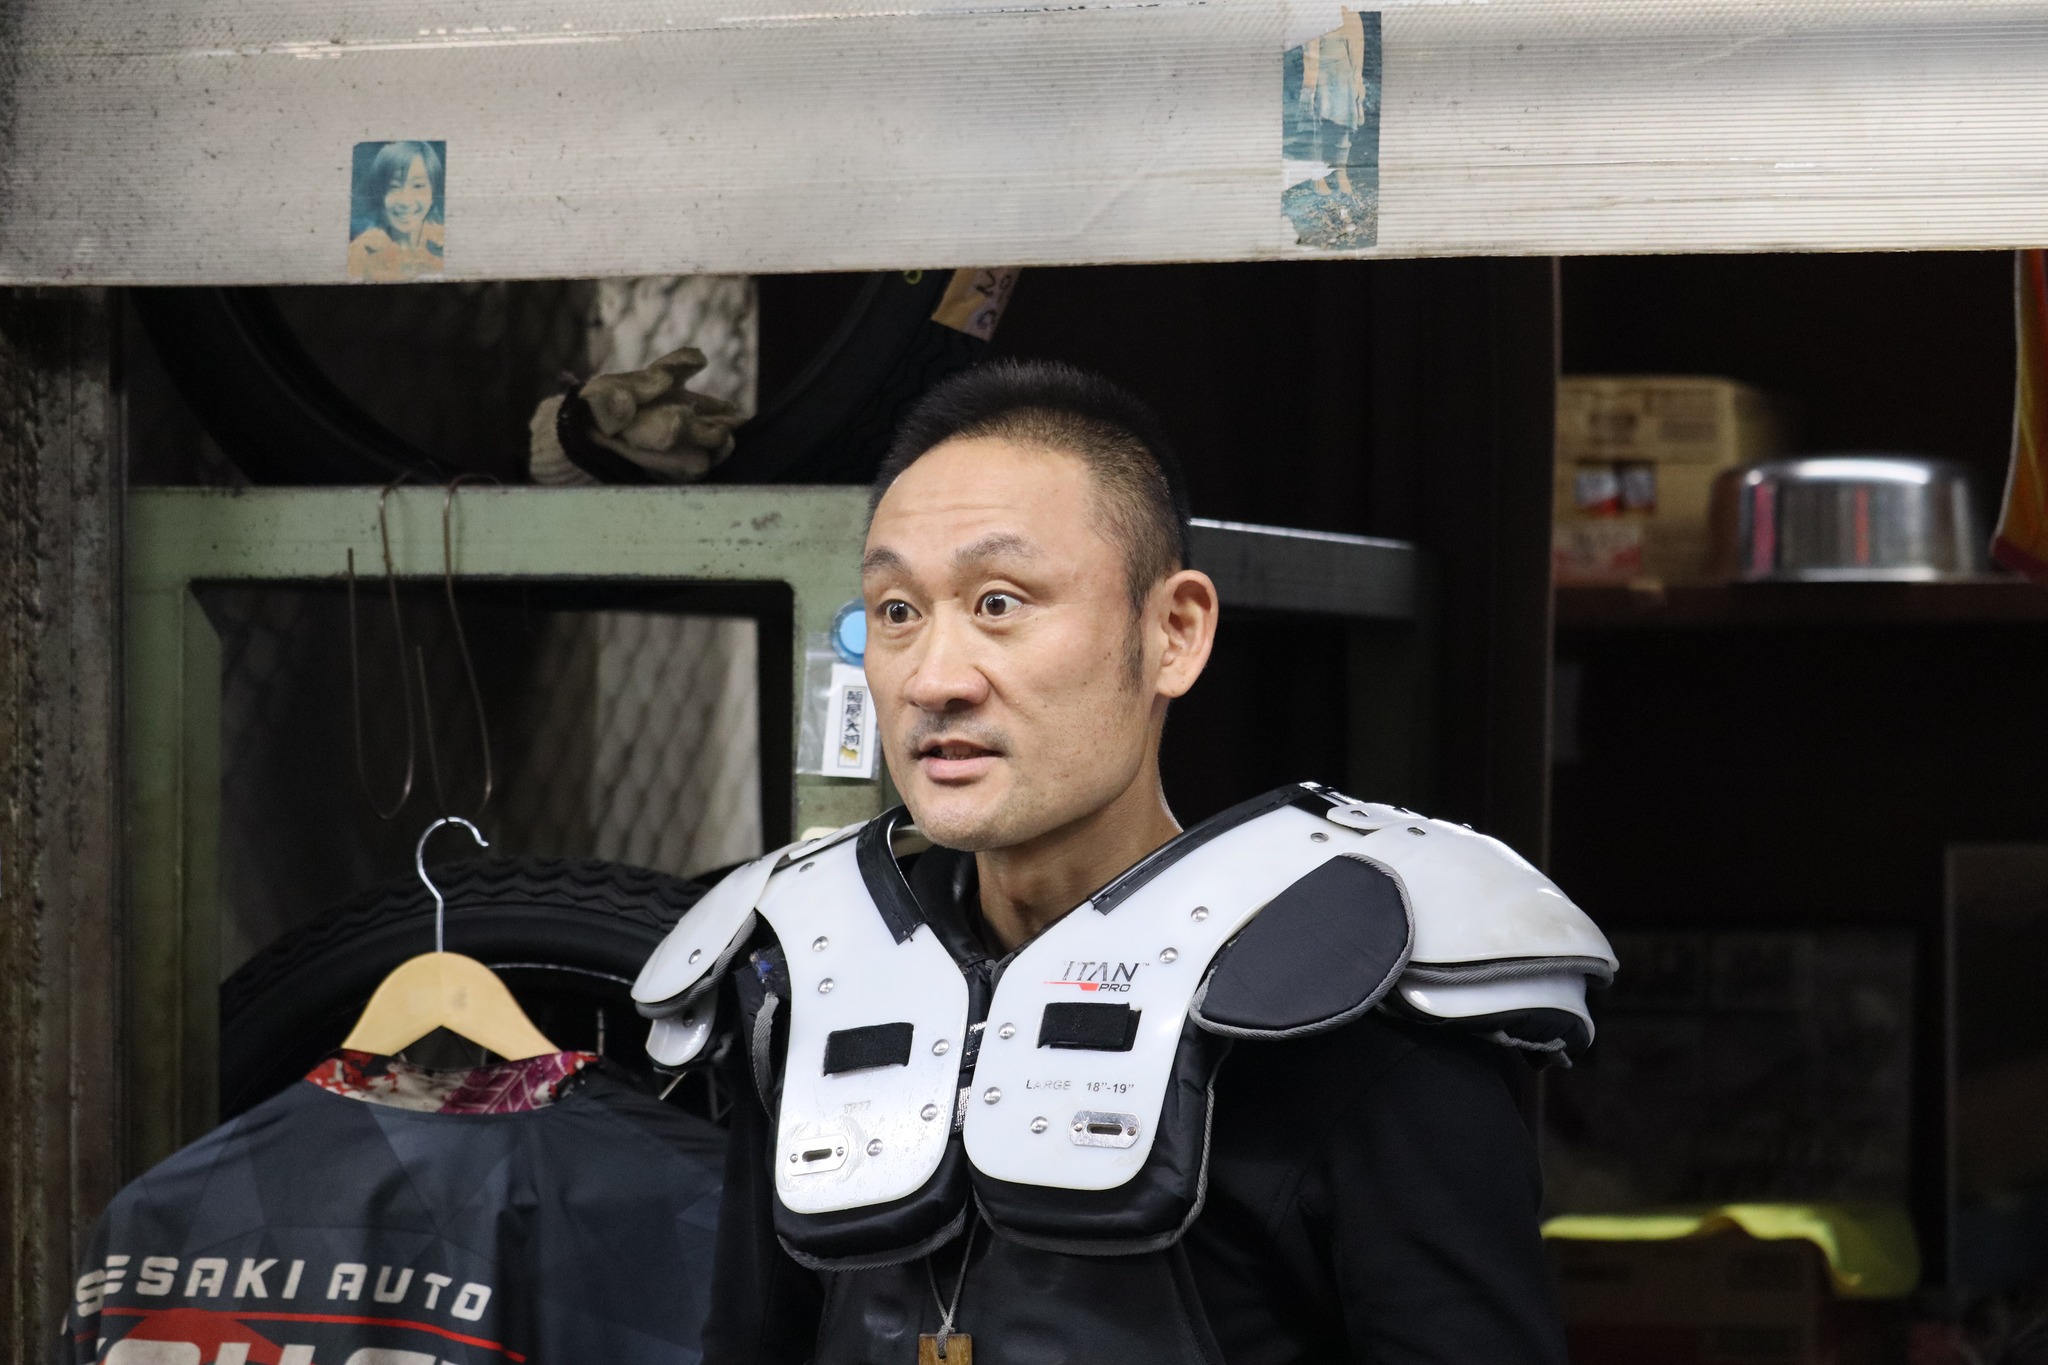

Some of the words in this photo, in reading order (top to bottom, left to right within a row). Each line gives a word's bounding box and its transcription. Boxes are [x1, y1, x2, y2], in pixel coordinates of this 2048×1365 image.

[1098, 983, 1131, 993] PRO
[1026, 1079, 1071, 1091] LARGE
[326, 1262, 492, 1322] AUTO
